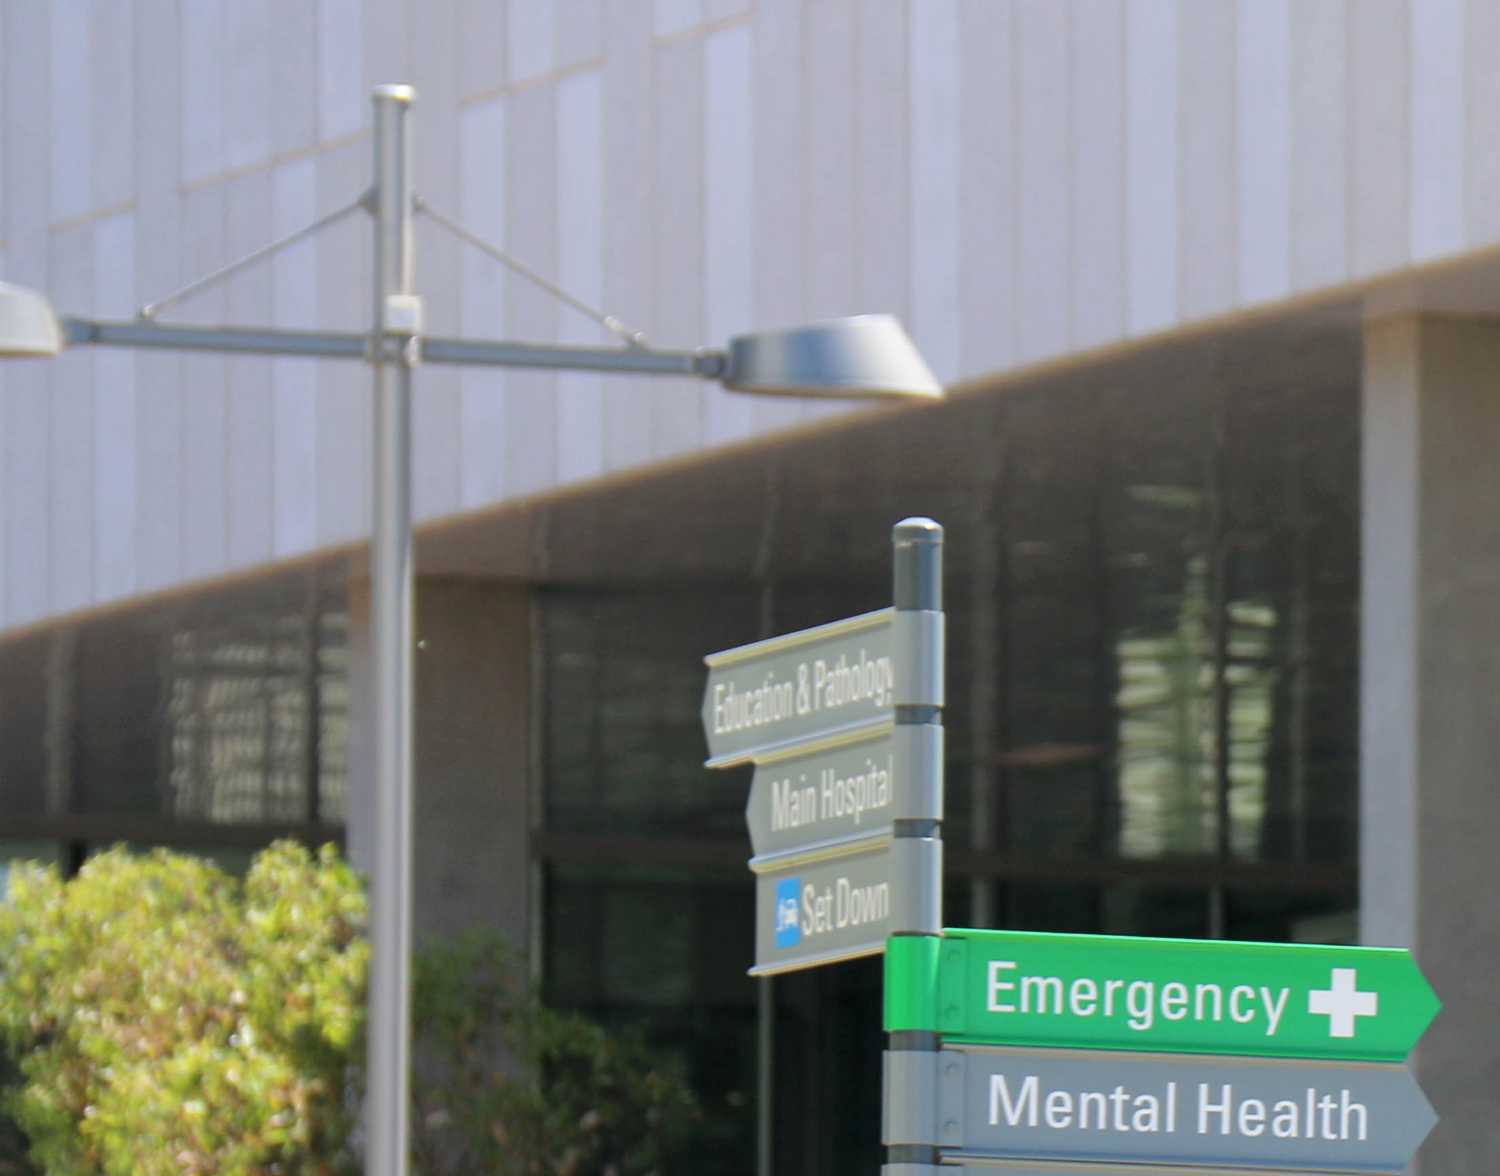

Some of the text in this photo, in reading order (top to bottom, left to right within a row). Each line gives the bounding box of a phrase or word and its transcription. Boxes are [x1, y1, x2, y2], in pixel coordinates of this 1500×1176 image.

[714, 648, 894, 735] Education & Pathology
[771, 755, 893, 832] Main Hospital
[802, 878, 889, 936] Set Down
[986, 960, 1290, 1036] Emergency
[987, 1074, 1369, 1141] Mental Health
